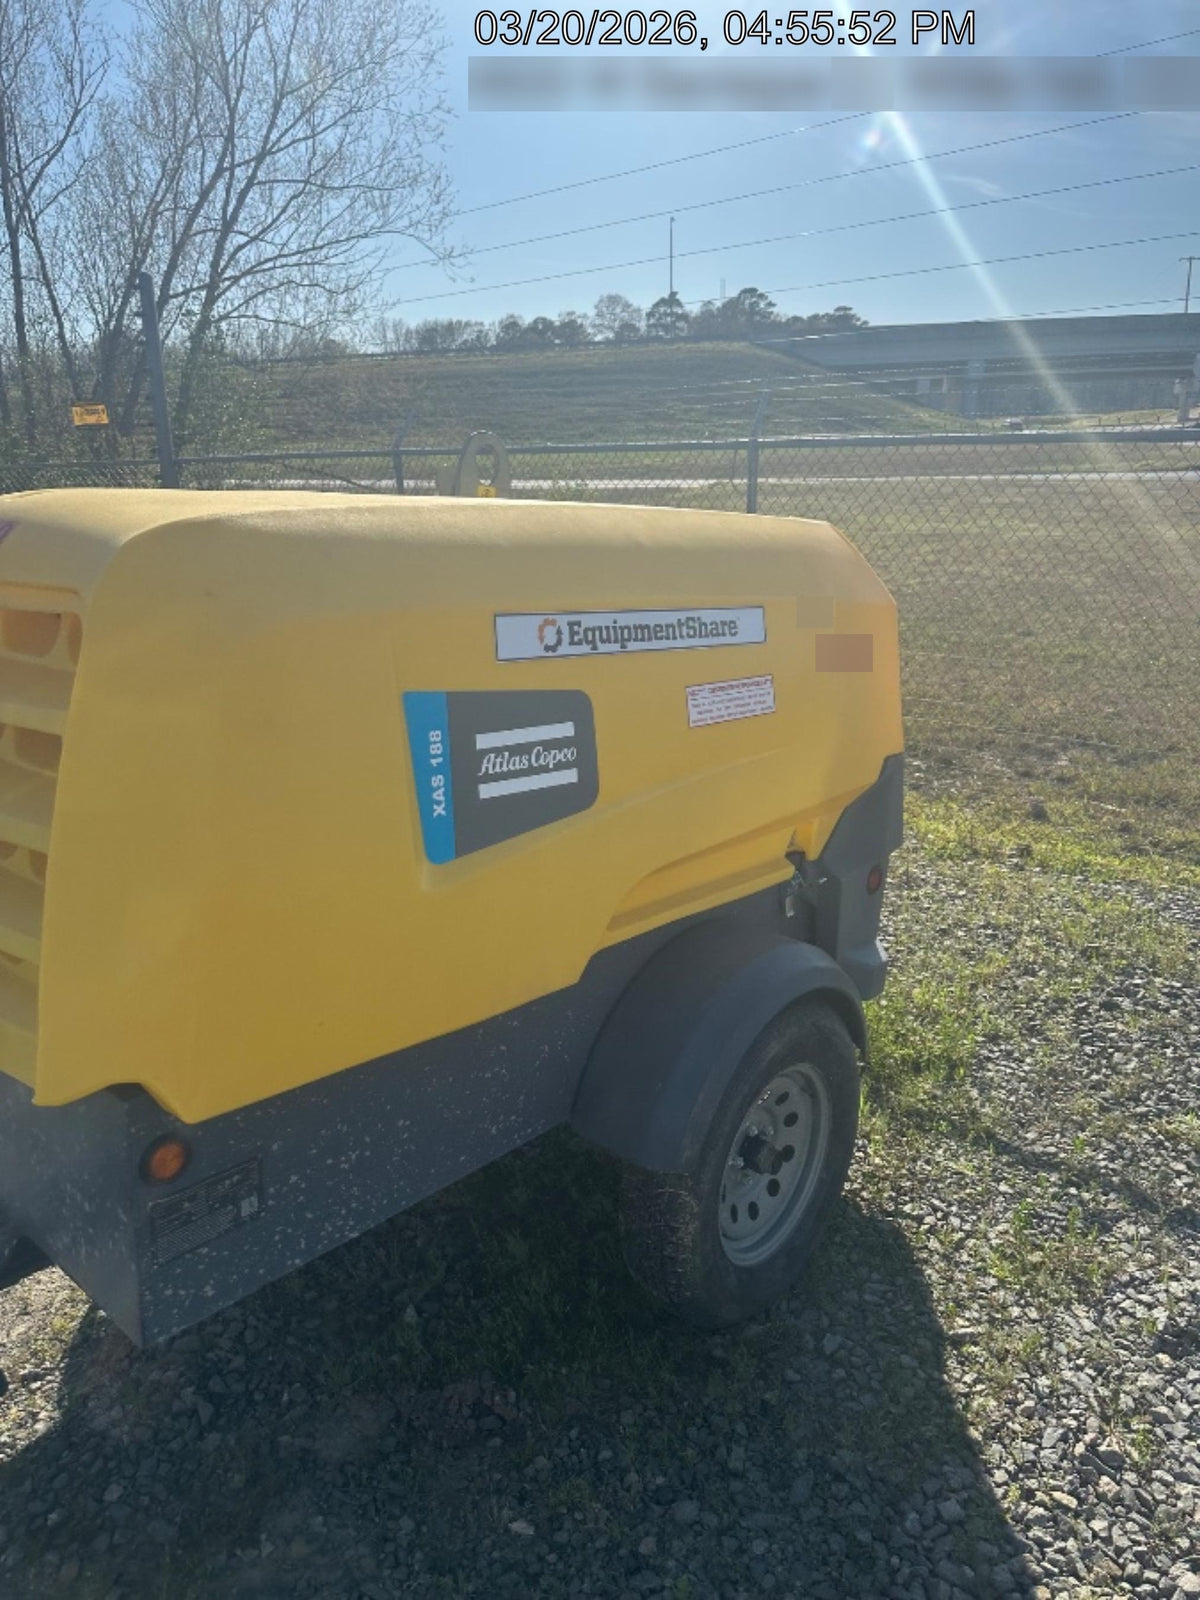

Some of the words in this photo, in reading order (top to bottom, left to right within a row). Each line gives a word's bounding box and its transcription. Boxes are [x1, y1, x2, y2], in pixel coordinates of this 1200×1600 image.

[567, 616, 739, 651] EquipmentShare
[429, 729, 443, 767] 188
[477, 751, 529, 776] Atlas
[531, 746, 577, 769] Copco
[432, 774, 447, 818] XAS
